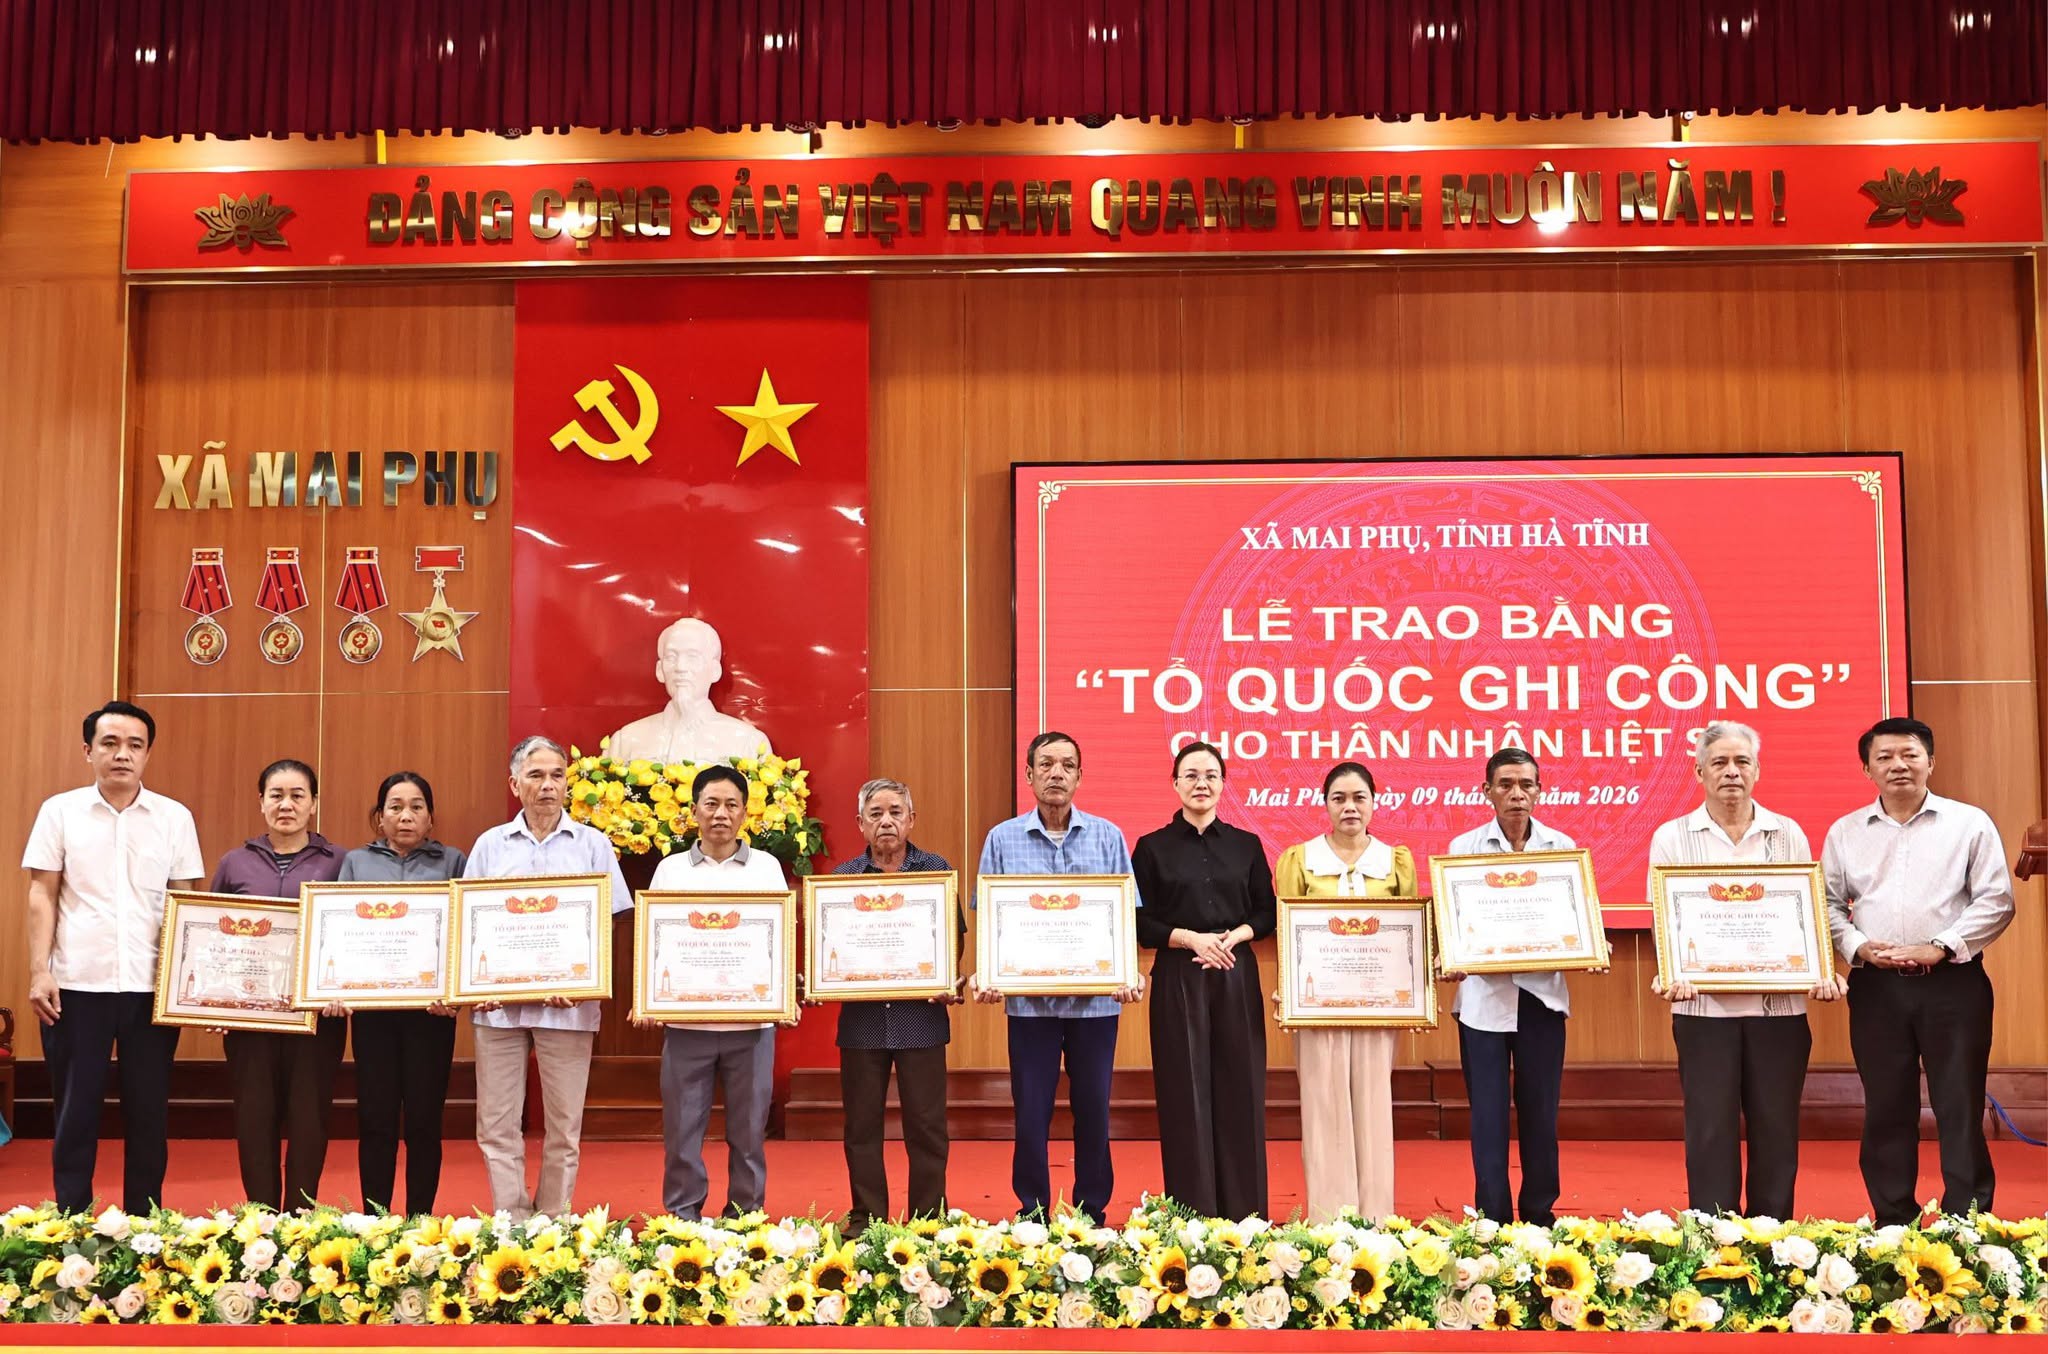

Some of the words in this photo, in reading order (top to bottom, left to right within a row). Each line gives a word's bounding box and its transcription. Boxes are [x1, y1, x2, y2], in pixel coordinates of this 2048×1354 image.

[368, 175, 514, 242] ĐẢNG
[529, 177, 672, 249] CỘNG
[687, 167, 799, 236] SẢN
[818, 172, 929, 244] VIỆT
[946, 180, 1072, 232] NAM
[1090, 176, 1277, 236] QUANG
[1294, 175, 1422, 227] VINH
[1441, 161, 1602, 225] MUÔN
[1619, 158, 1754, 222] NĂM
[154, 440, 233, 509] XÃ
[249, 451, 363, 508] MAI
[383, 451, 498, 520] PHỤ
[1240, 521, 1281, 550] XÃ
[1291, 526, 1352, 550] MAI
[1359, 525, 1431, 555] PHỤ,
[1436, 518, 1513, 548] TỈNH
[1520, 517, 1563, 547] HÀ
[1572, 517, 1650, 547] TĨNH
[1222, 598, 1293, 642] LỄ
[1311, 605, 1480, 641] TRAO
[1501, 595, 1673, 640] BẰNG
[1076, 657, 1203, 714] “TỔ
[1227, 655, 1434, 716] QUỐC
[1459, 665, 1580, 711] GHI
[1606, 653, 1850, 711] CÔNG”
[1170, 730, 1268, 760] CHO
[1281, 721, 1410, 759] THÂN
[1428, 720, 1564, 759] NHÂN
[1581, 719, 1672, 764] LIỆT
[1244, 787, 1290, 807] Mai
[1411, 786, 1439, 806] 09
[1443, 786, 1495, 809] thán
[1586, 785, 1640, 806] 2026
